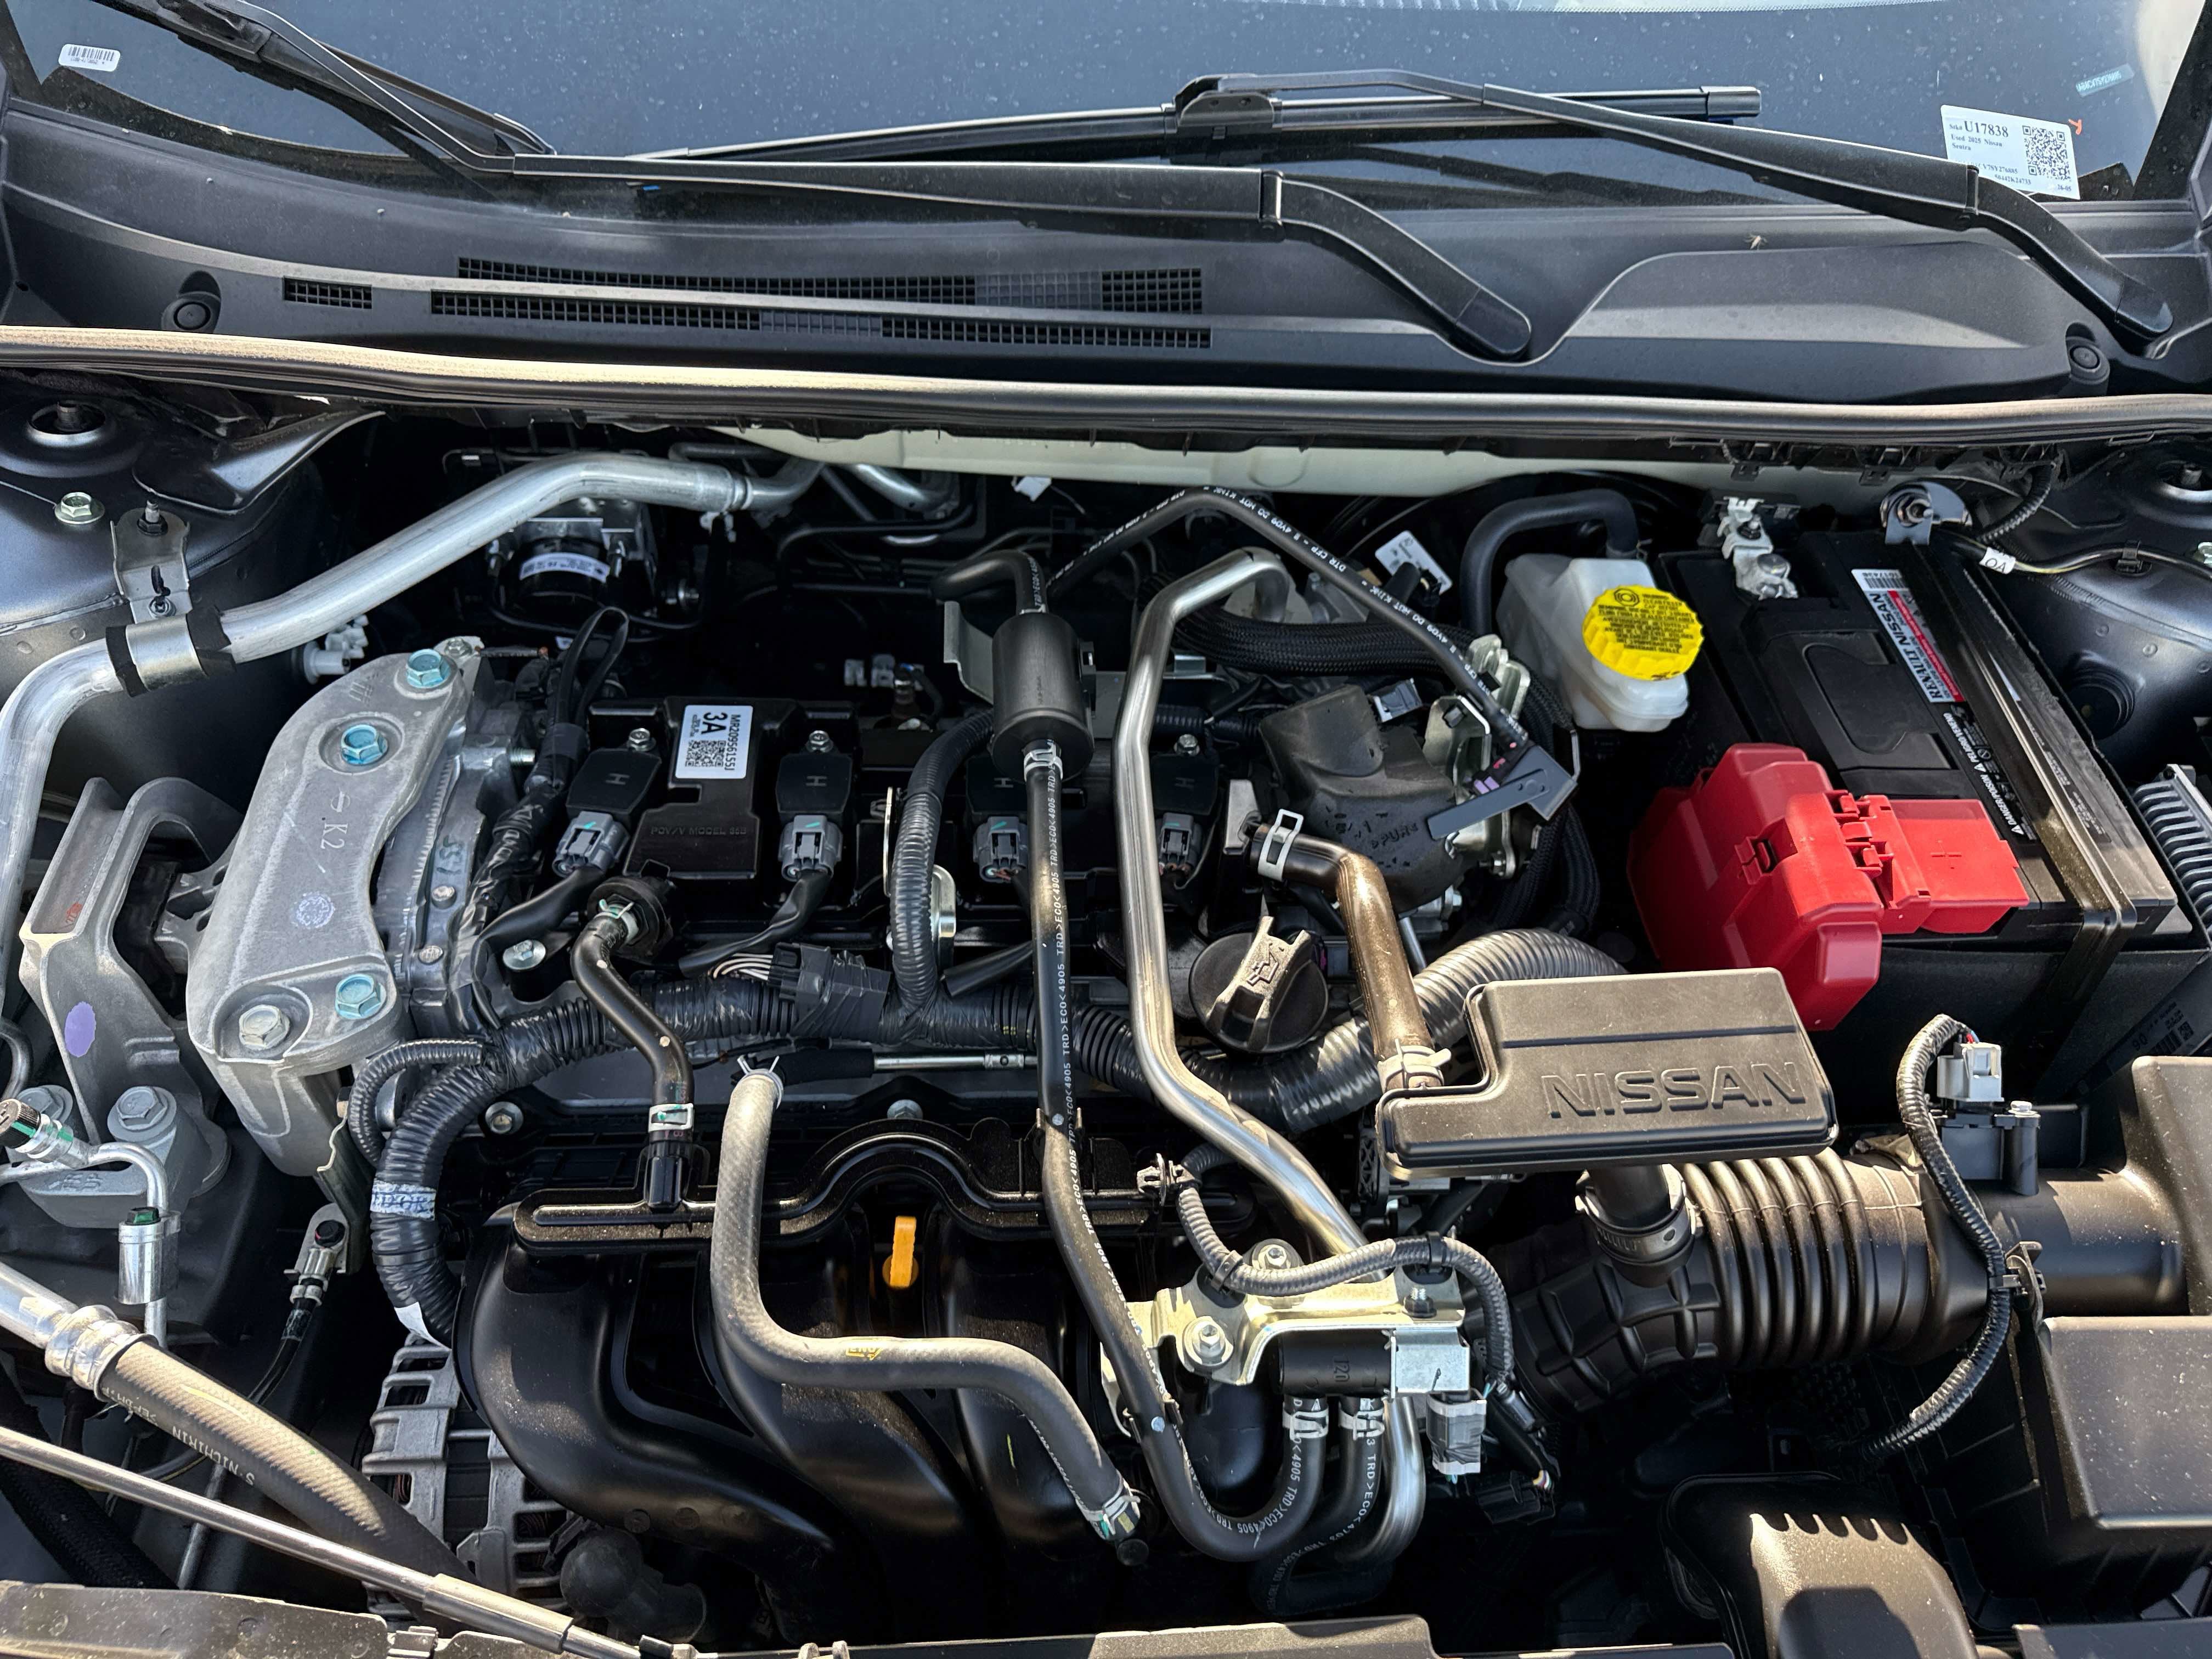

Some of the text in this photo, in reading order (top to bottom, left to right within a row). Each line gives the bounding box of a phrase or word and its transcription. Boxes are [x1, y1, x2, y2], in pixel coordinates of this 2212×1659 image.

[1964, 120, 2008, 137] U17838
[1869, 593, 1911, 646] NISSAN
[1903, 648, 1943, 700] RENAULT
[701, 712, 728, 735] 3A
[320, 822, 348, 849] K2
[689, 826, 726, 835] MODEL
[1048, 797, 1058, 866] TRD>ECO<4905
[1051, 872, 1064, 956] TRD>ECO<4905
[1057, 963, 1070, 1056] TRD>ECO<4905
[1540, 1060, 1807, 1120] NISSAN
